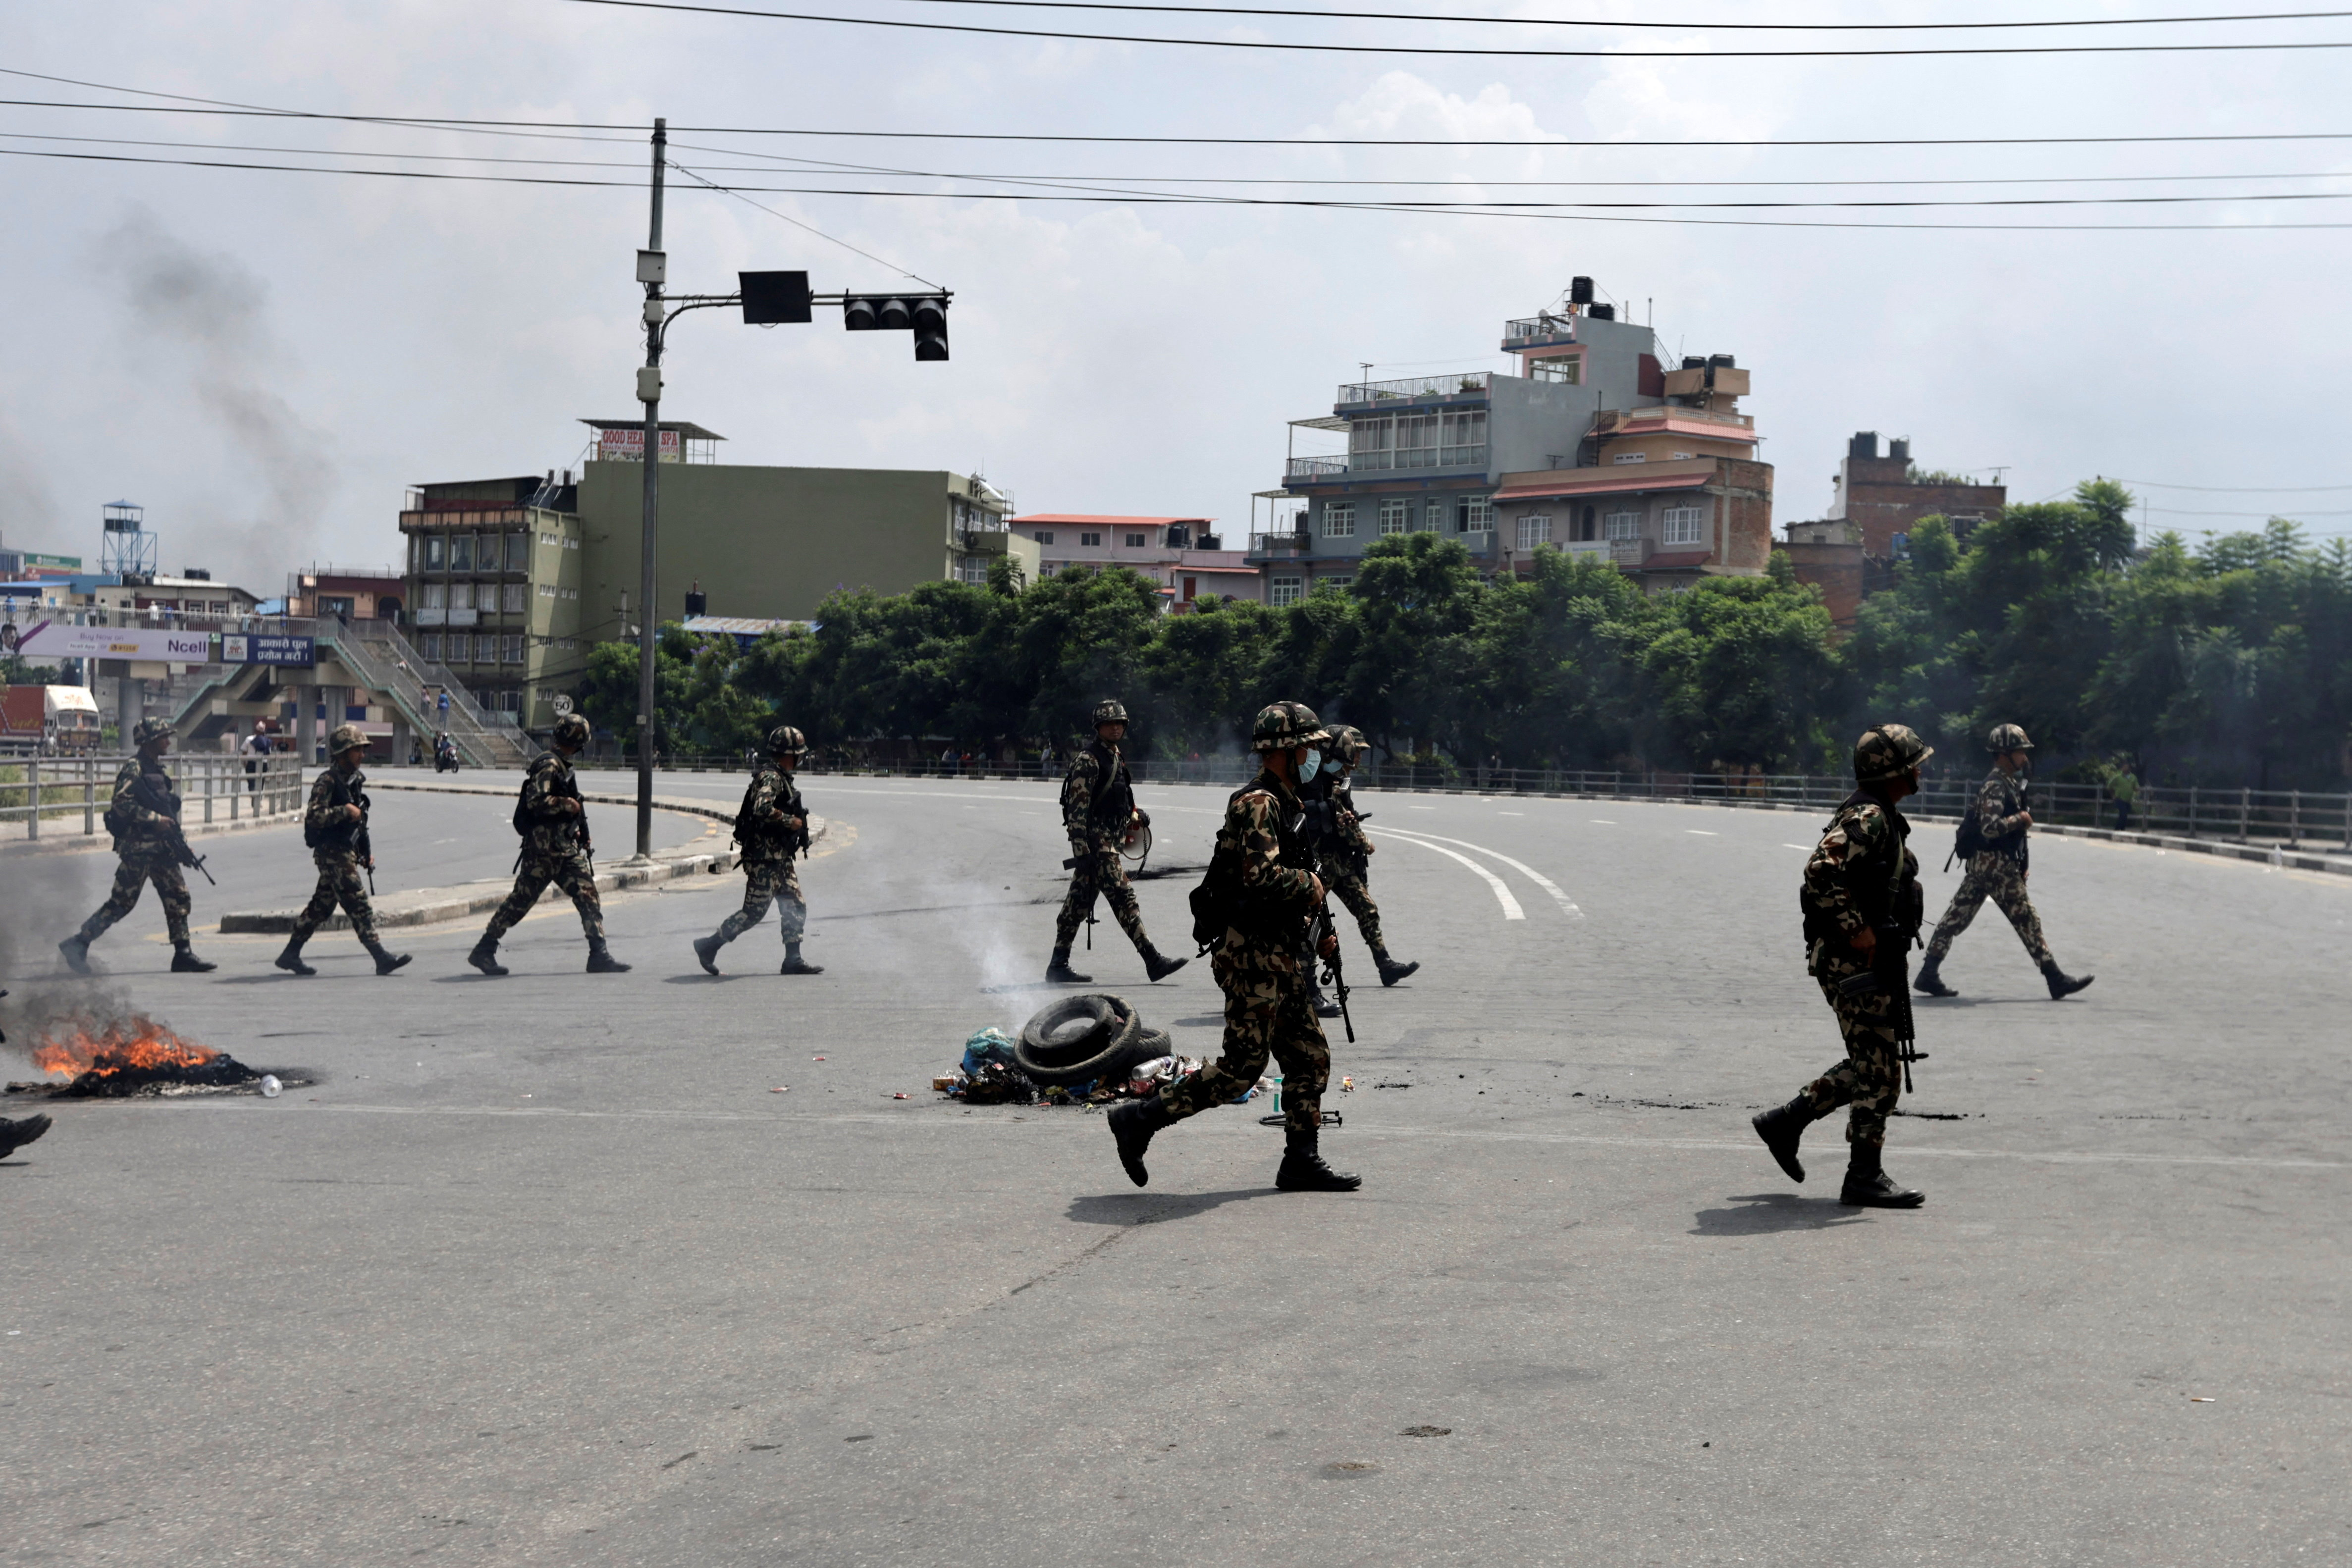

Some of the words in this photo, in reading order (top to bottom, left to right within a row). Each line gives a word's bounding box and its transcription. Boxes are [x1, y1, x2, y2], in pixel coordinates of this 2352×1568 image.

[603, 430, 625, 444] GOOD
[661, 432, 678, 446] SPA
[80, 632, 94, 641] Buy
[168, 639, 206, 653] Ncell
[292, 640, 308, 650] पुल
[258, 649, 282, 661] प्रयोग
[556, 701, 569, 710] 50
